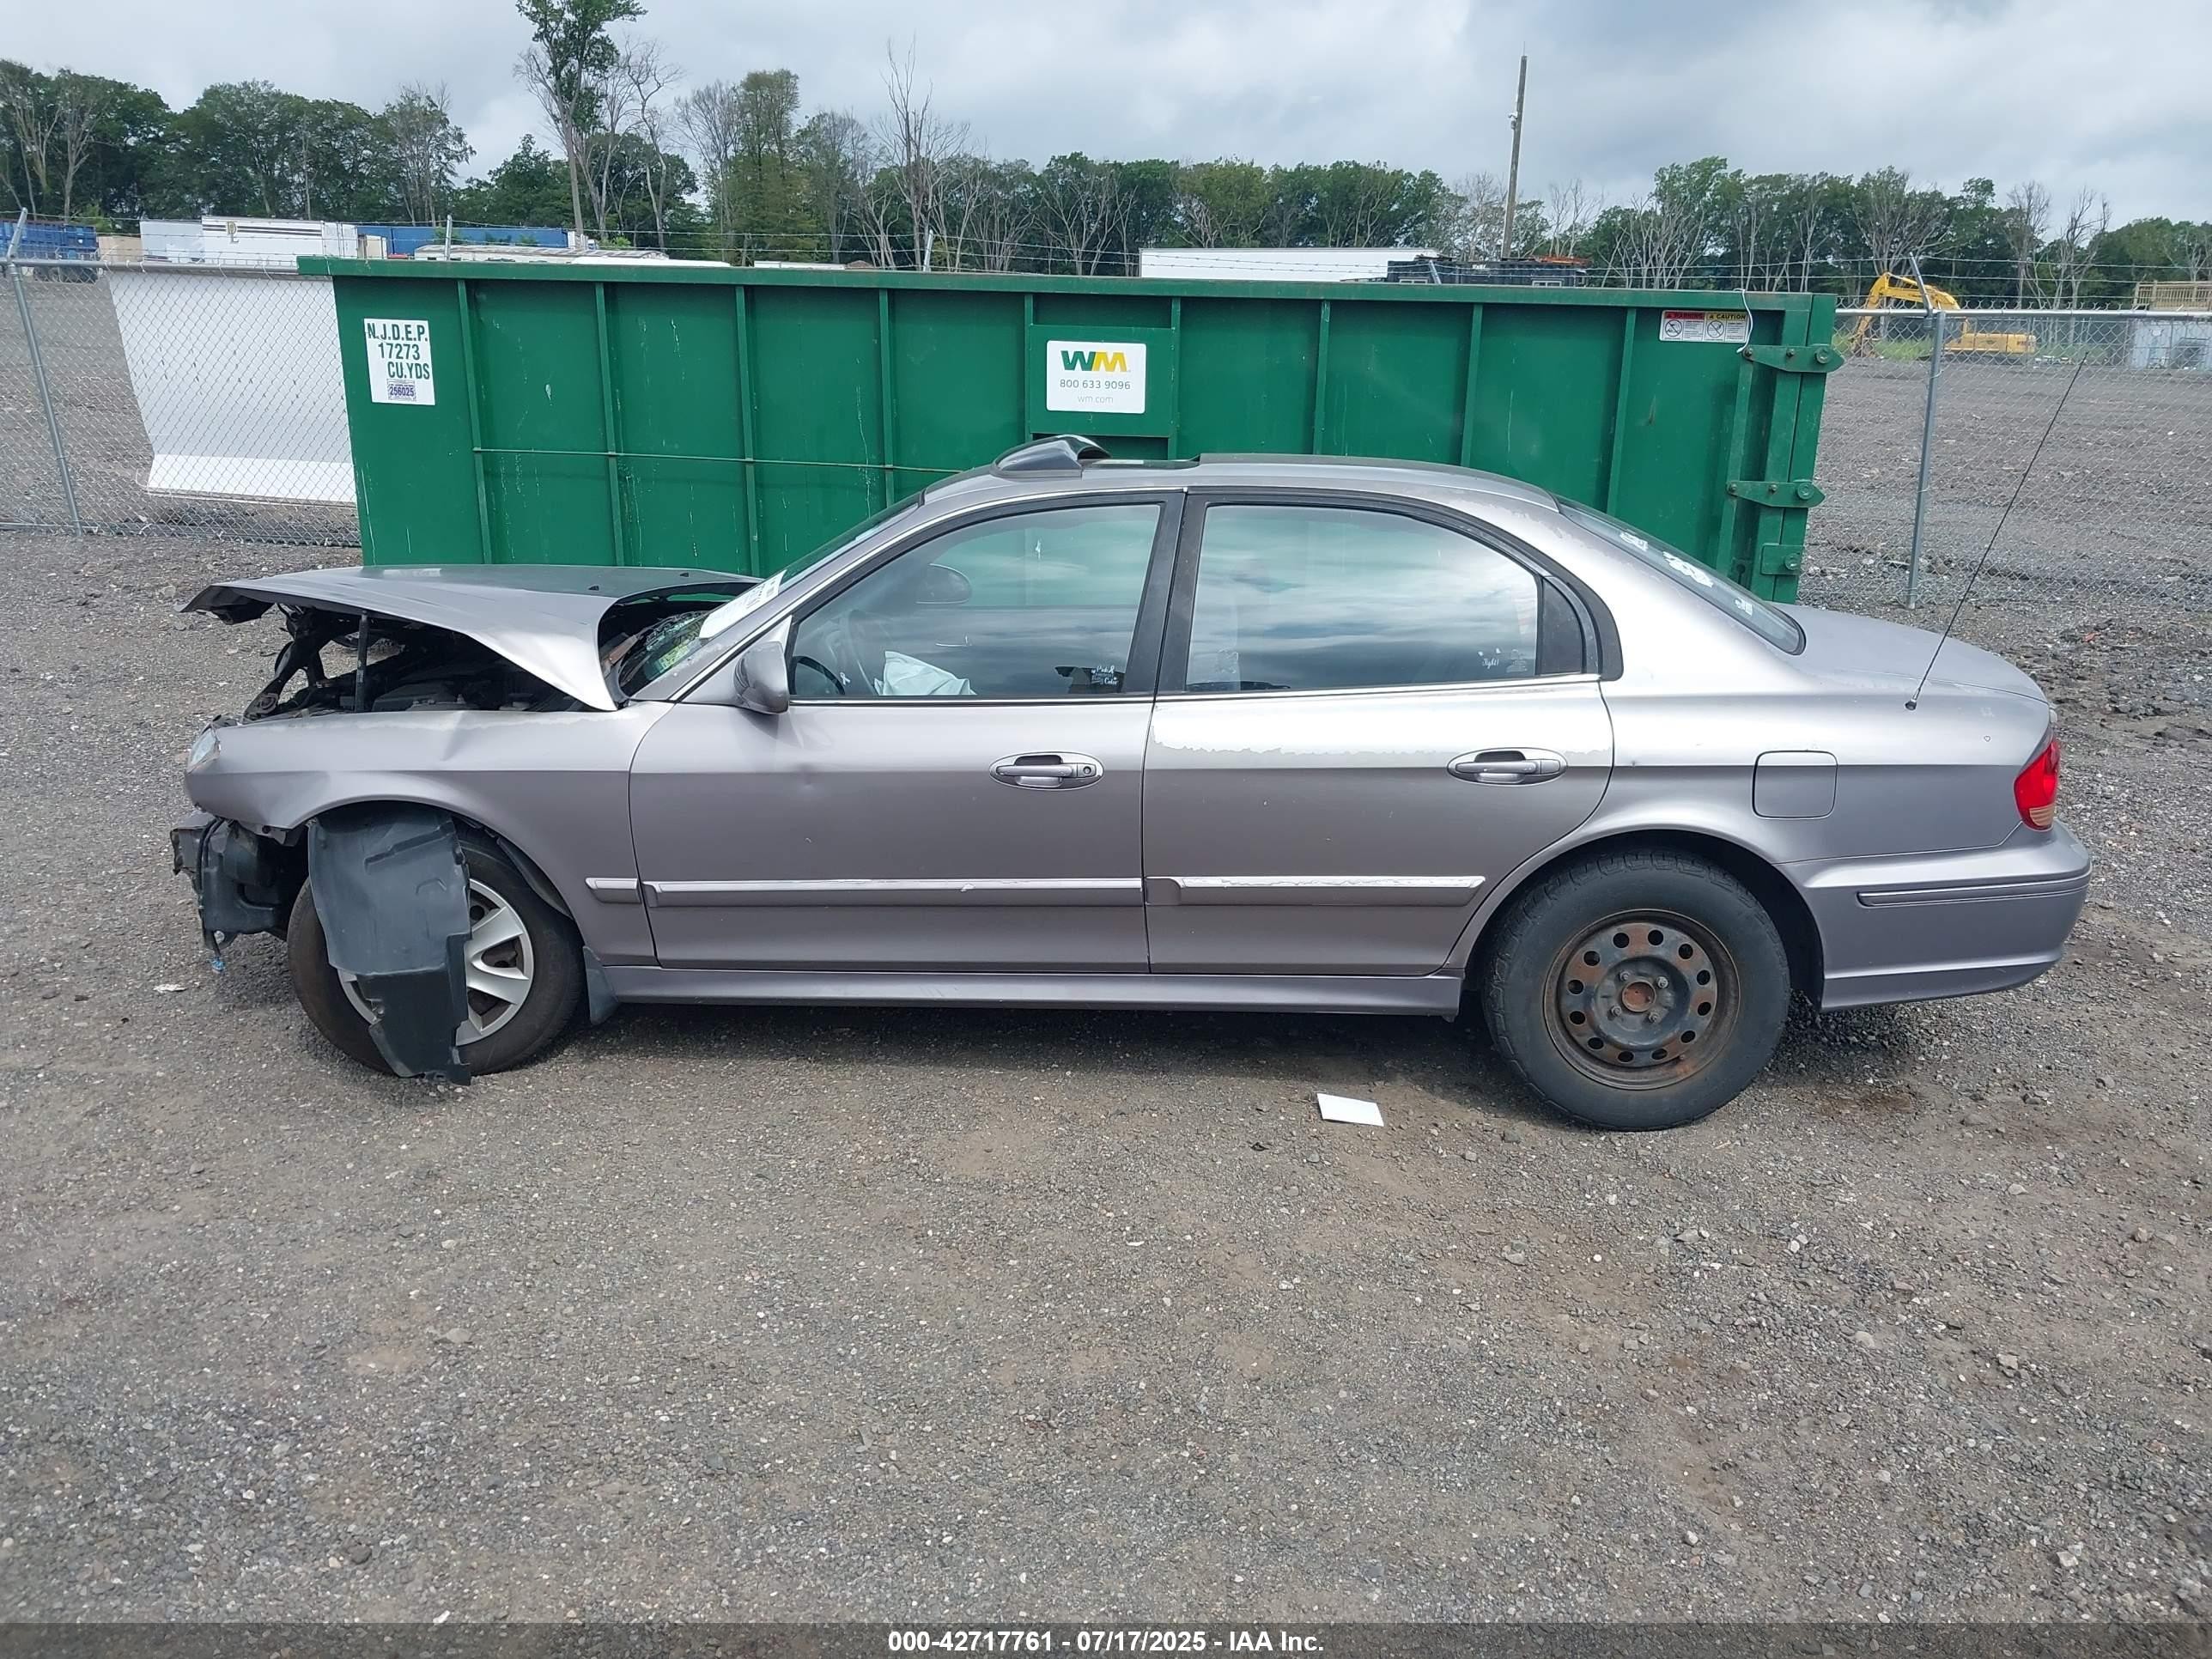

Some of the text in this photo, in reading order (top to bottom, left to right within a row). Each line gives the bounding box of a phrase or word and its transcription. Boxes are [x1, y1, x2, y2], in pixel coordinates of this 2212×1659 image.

[367, 323, 428, 342] N.J.D.E.P.
[378, 342, 420, 361] 17273
[1060, 349, 1127, 373] WM
[1060, 379, 1131, 390] 800 633 9096
